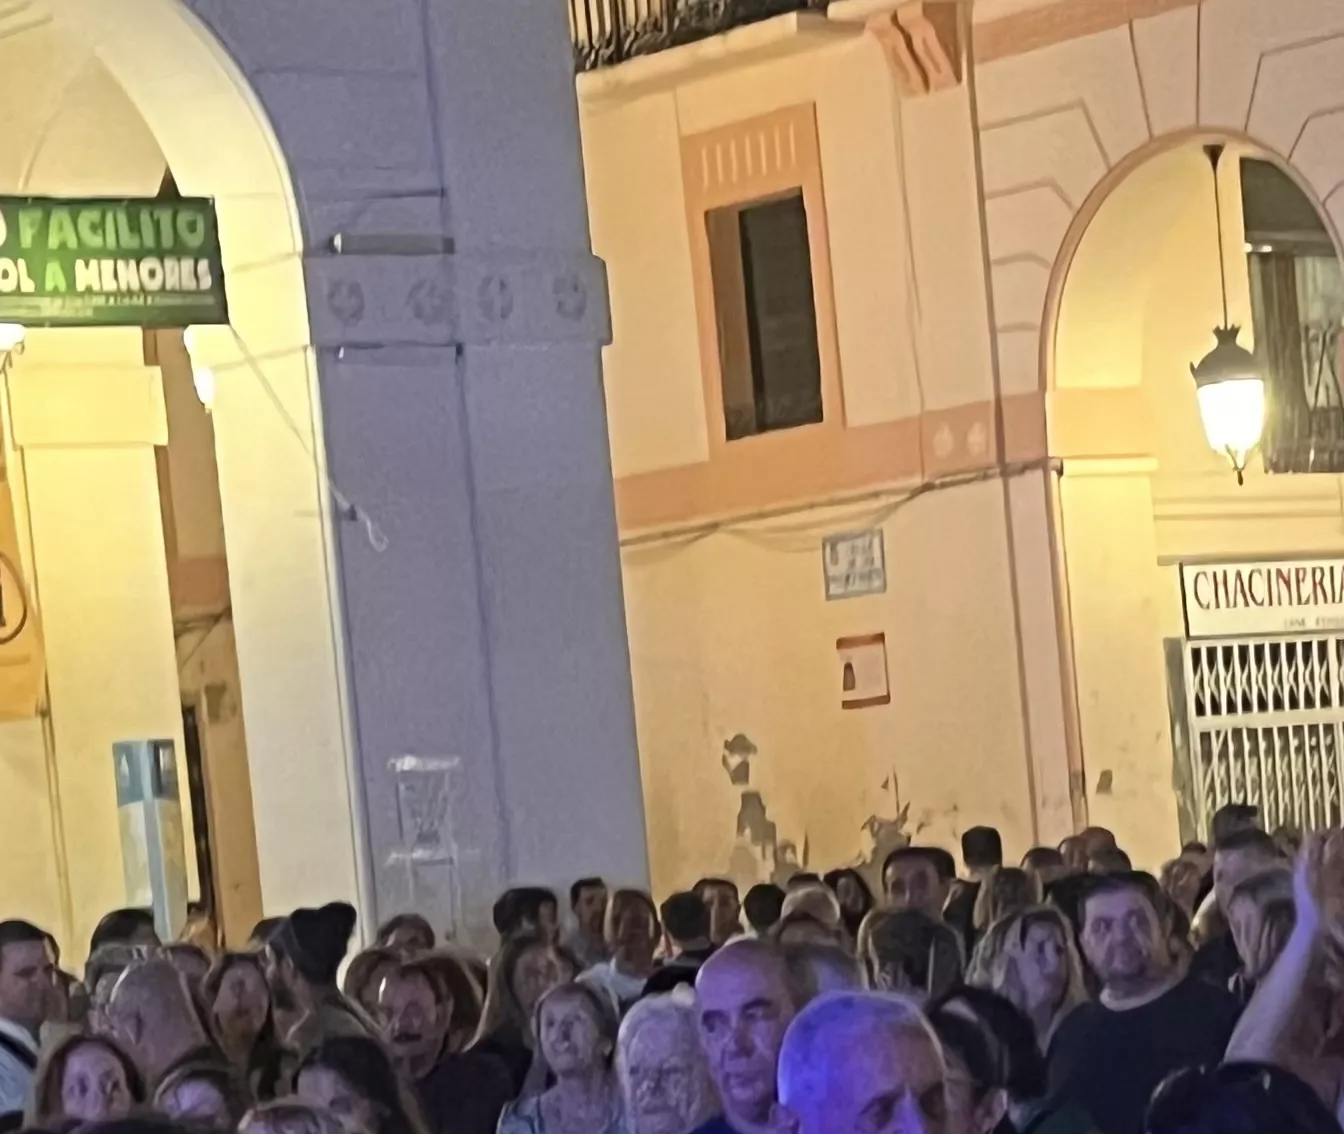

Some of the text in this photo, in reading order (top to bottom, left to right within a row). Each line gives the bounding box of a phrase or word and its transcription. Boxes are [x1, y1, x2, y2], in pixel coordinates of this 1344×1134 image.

[18, 205, 206, 250] FACILITO
[44, 260, 67, 293] A
[74, 257, 213, 293] MENORES
